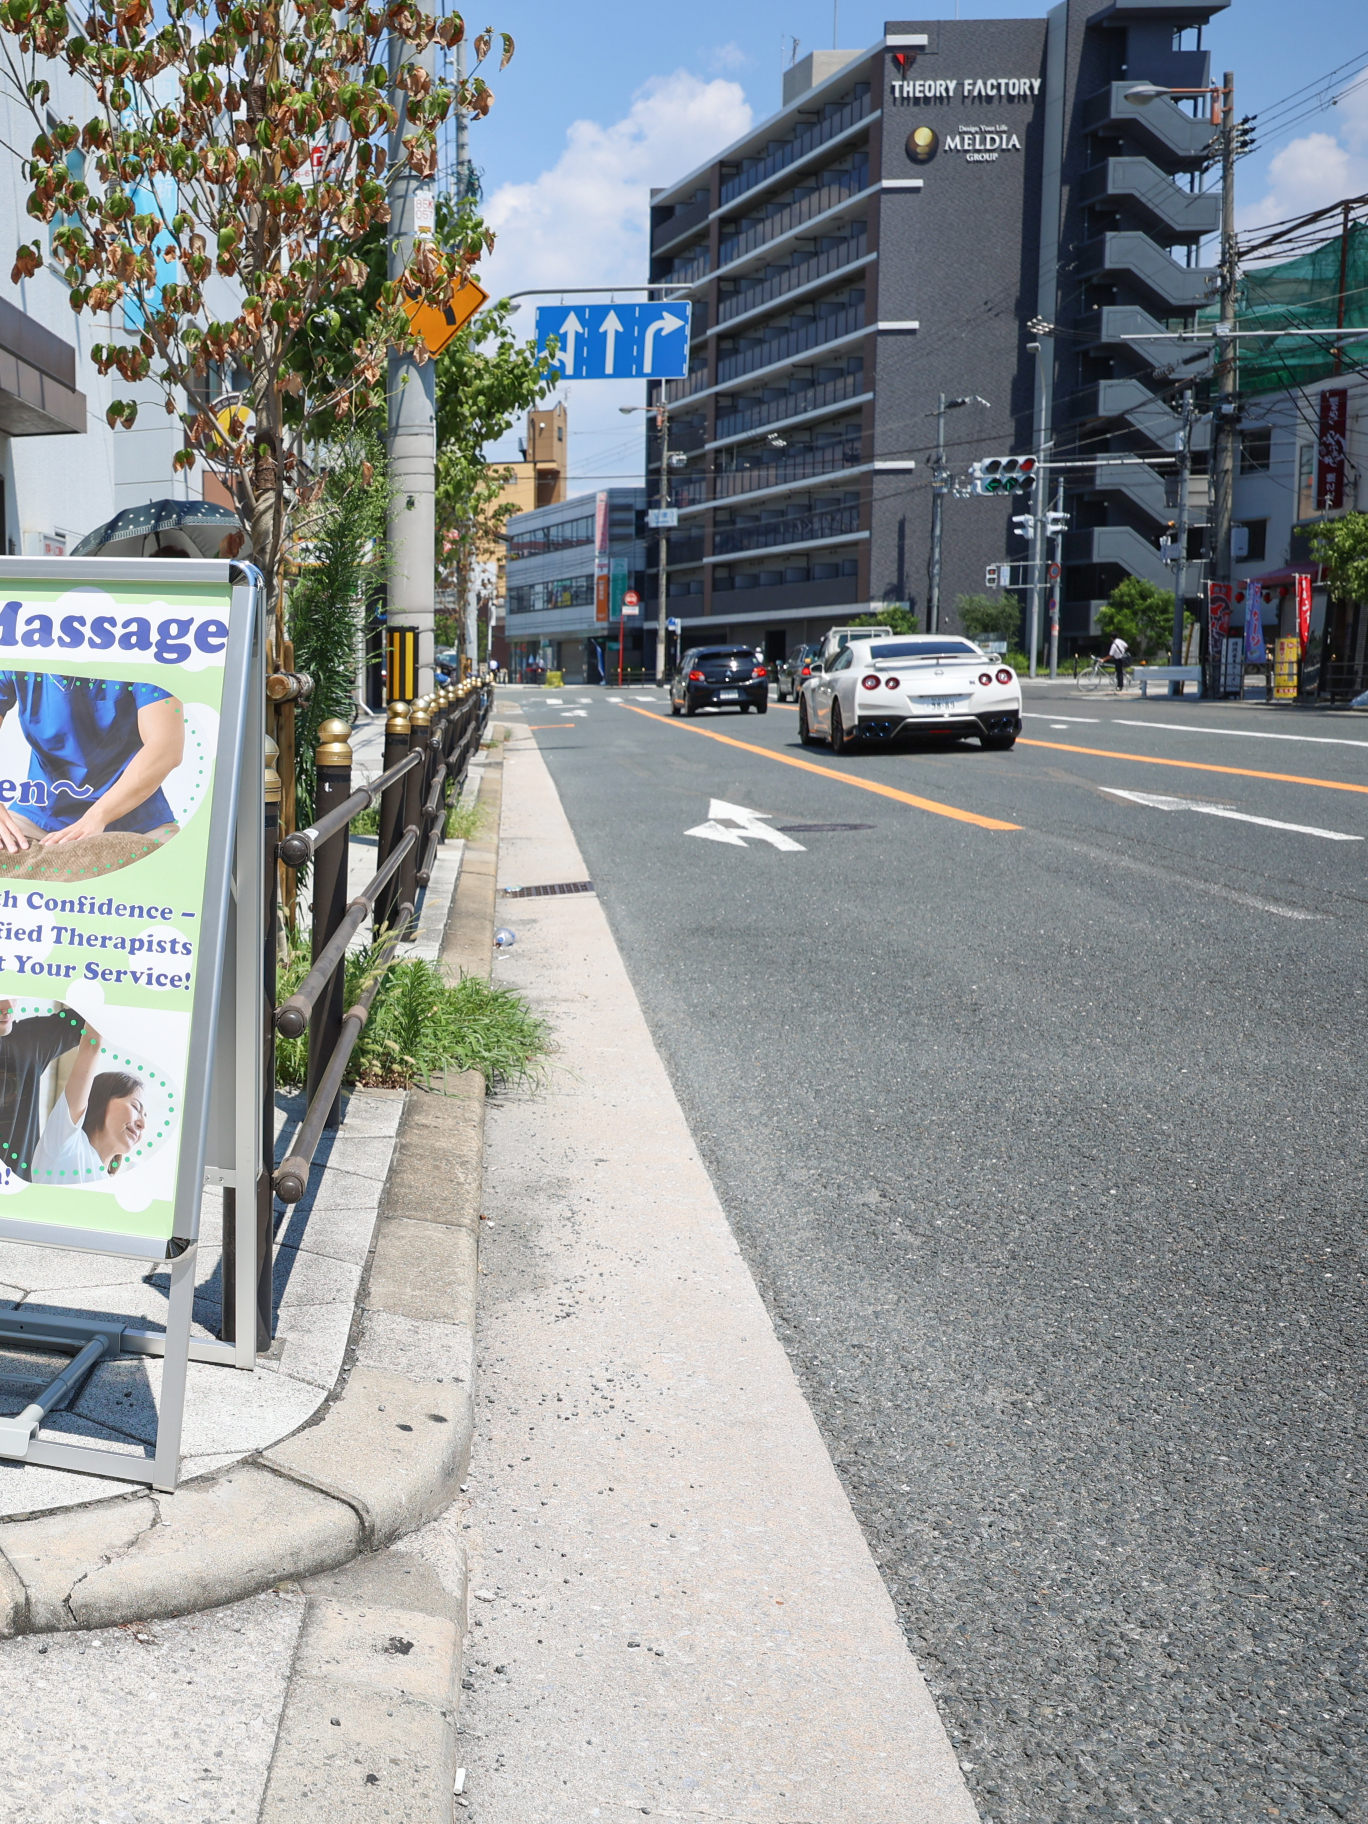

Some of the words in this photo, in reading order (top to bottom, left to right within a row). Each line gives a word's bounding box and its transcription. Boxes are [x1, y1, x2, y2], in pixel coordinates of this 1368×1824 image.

[892, 79, 957, 98] THEORY
[963, 78, 1042, 97] FACTORY
[958, 125, 980, 133] Design
[980, 124, 995, 132] Your
[996, 124, 1009, 132] Life
[944, 133, 1021, 151] MELDIA
[966, 153, 998, 162] GROUP
[415, 210, 433, 220] 057
[26, 892, 174, 921] Confidence
[51, 925, 193, 956] Therapists
[14, 955, 76, 979] Your
[83, 961, 192, 991] Service!
